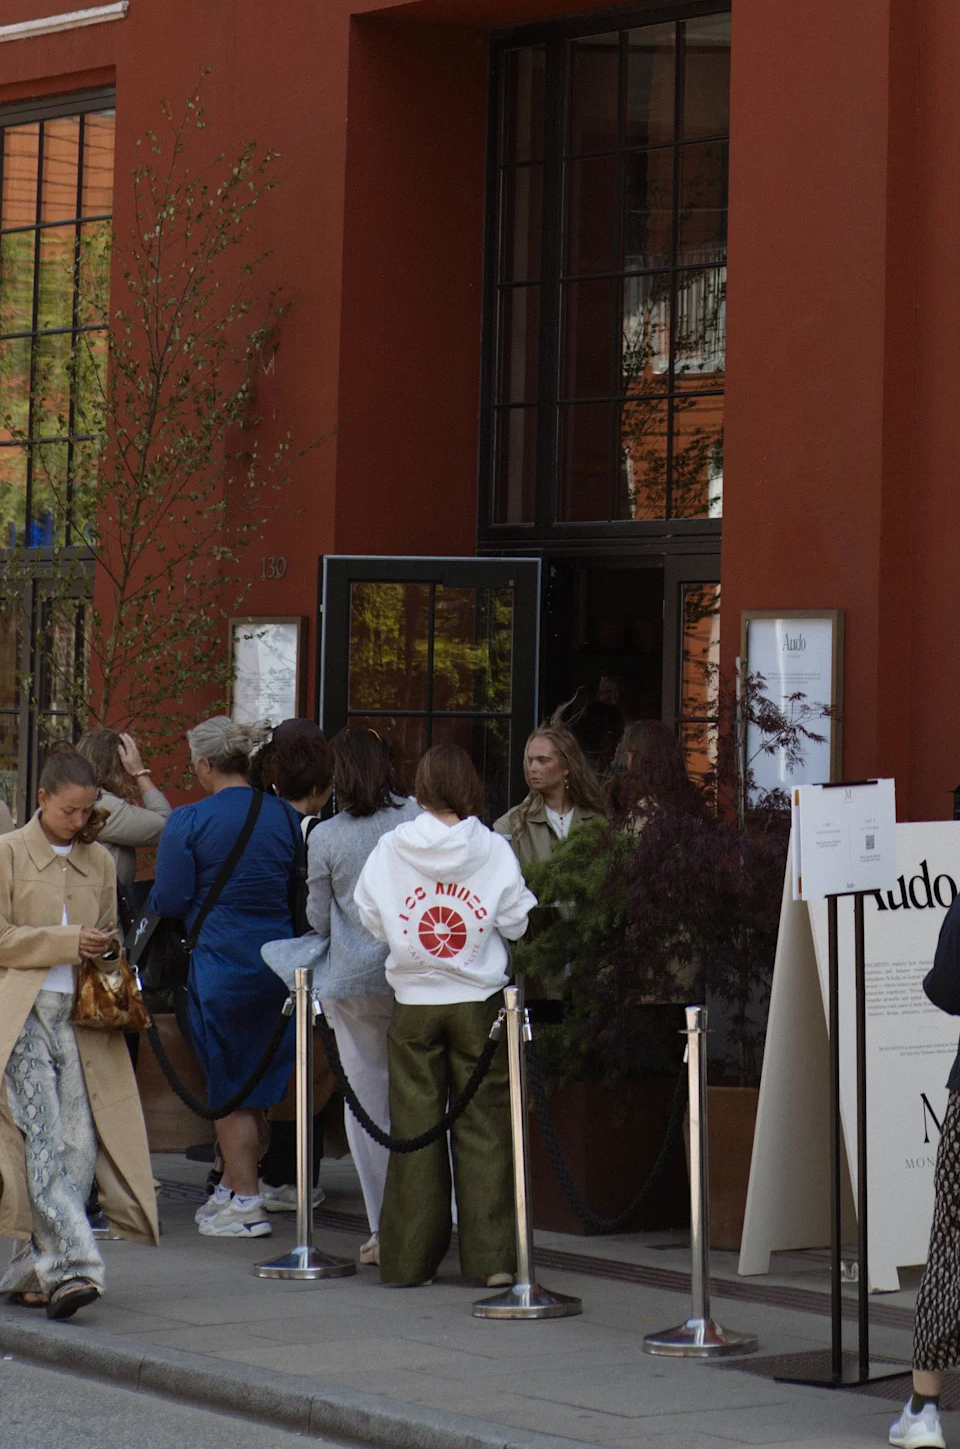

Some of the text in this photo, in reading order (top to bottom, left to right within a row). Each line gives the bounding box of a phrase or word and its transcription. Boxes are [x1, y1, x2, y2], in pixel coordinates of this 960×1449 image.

[260, 556, 287, 579] 130
[783, 633, 806, 651] Audo
[399, 887, 426, 921] LOS
